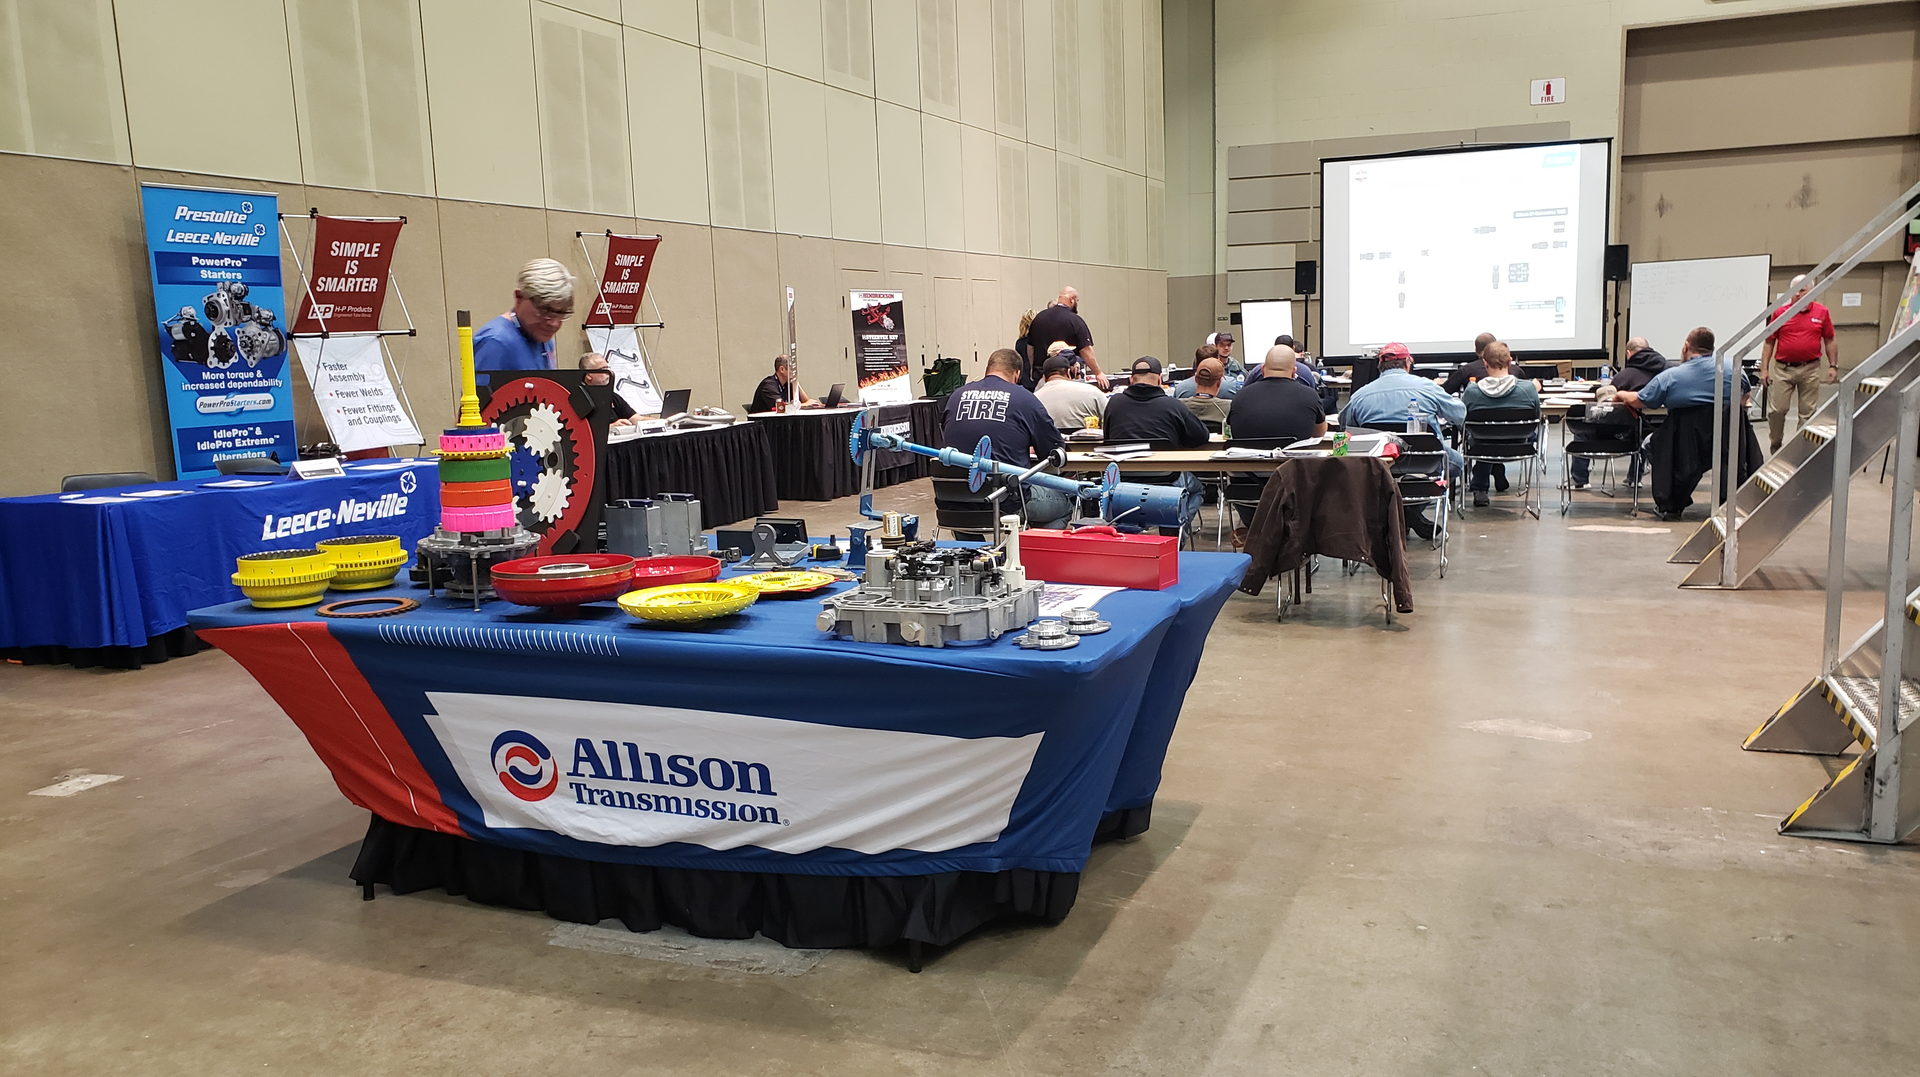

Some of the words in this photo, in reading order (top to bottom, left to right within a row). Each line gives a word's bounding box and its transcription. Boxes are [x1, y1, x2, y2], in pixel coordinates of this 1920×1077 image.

[1541, 95, 1555, 103] FIRE
[174, 205, 247, 224] Prestolite
[330, 241, 381, 258] SIMPLE
[614, 254, 645, 266] SIMPLE
[344, 260, 359, 275] IS
[200, 270, 242, 279] Starters
[621, 269, 630, 280] IS
[315, 276, 378, 293] SMARTER
[603, 281, 640, 294] SMARTER
[347, 305, 373, 313] Products
[322, 362, 348, 371] Faster
[202, 371, 225, 380] More
[226, 370, 254, 379] torque
[256, 370, 263, 378] &
[328, 373, 366, 382] Assembly
[181, 380, 225, 391] increased
[227, 379, 283, 389] dependability
[335, 389, 359, 399] Fewer
[360, 387, 384, 397] Welds
[960, 390, 1011, 401] SYRACUSE
[198, 399, 272, 409] PowerProStarters.com
[342, 405, 366, 415] Fewer
[366, 403, 396, 414] Fittings
[955, 400, 1009, 422] FIRE
[347, 417, 363, 427] and
[363, 414, 402, 426] Couplings
[255, 427, 262, 435] &
[196, 440, 233, 451] IdlePro
[212, 451, 267, 463] Alternators
[566, 737, 778, 796] Allison
